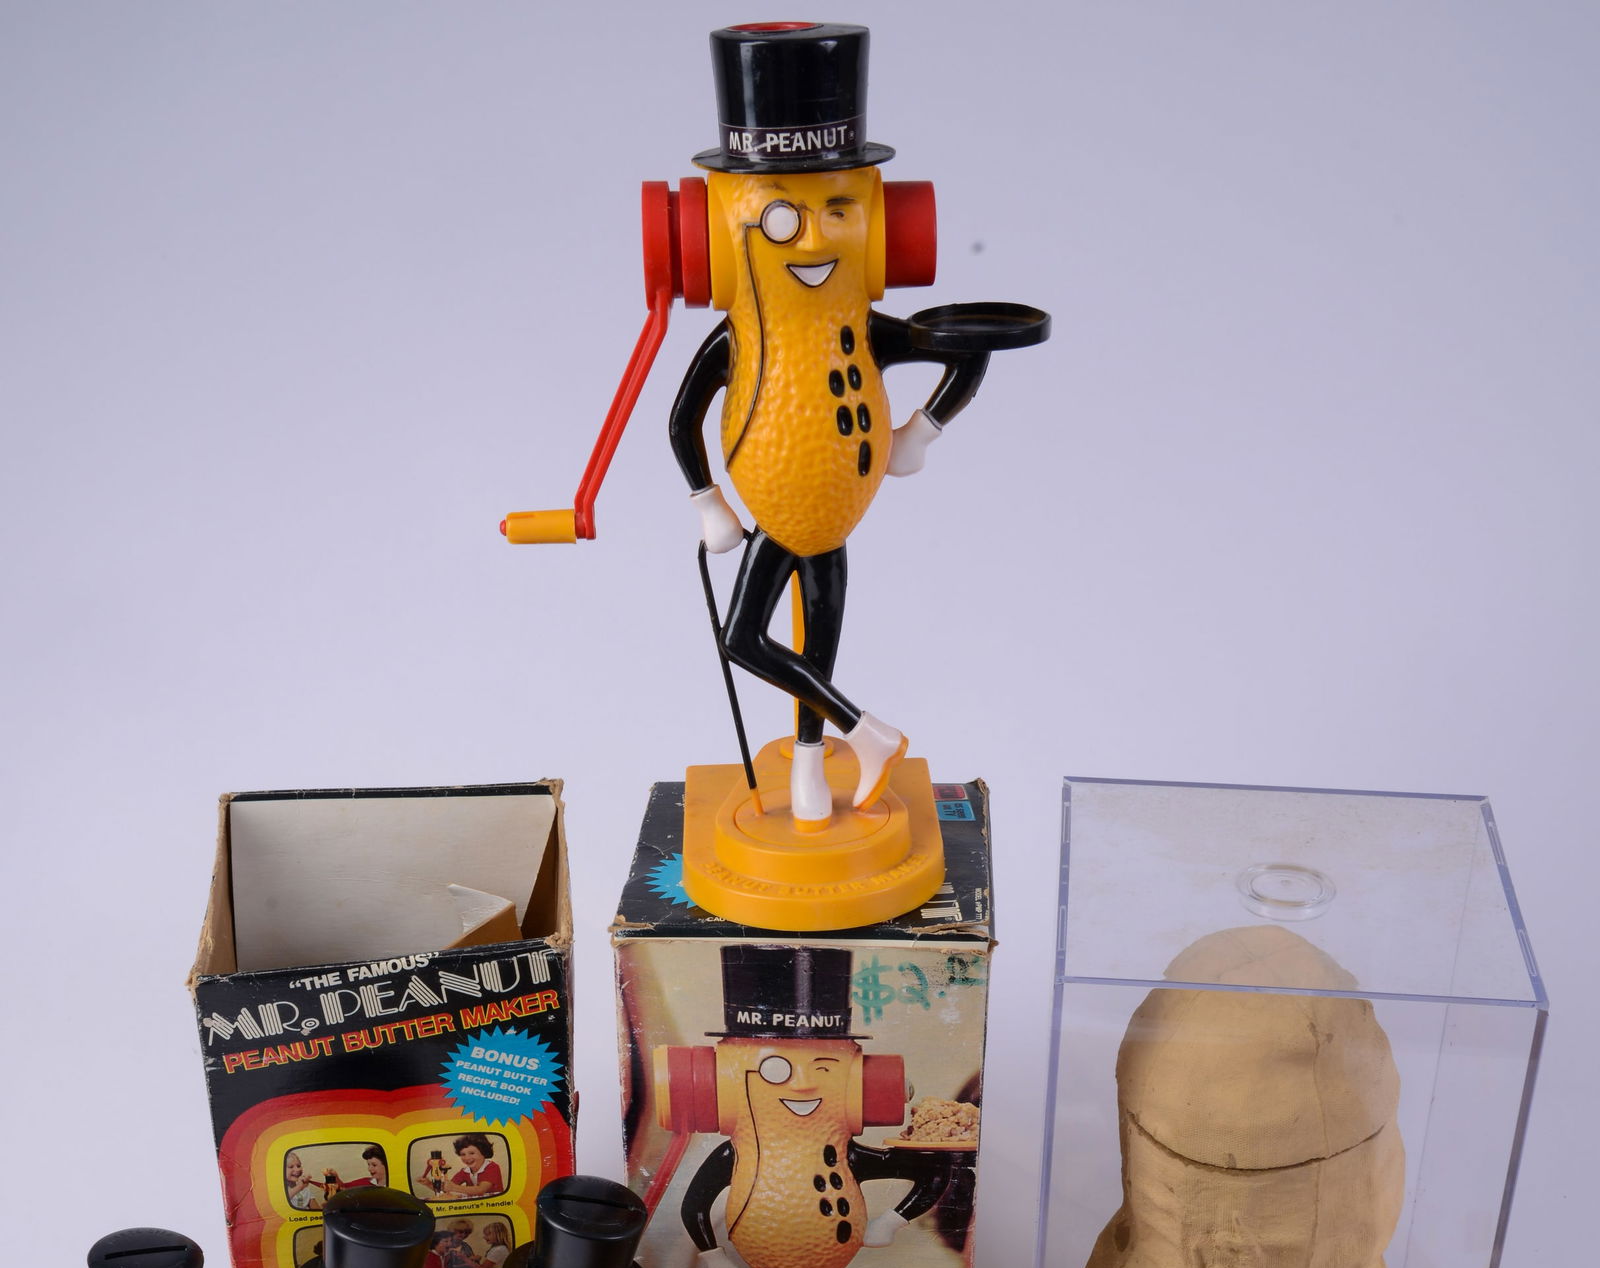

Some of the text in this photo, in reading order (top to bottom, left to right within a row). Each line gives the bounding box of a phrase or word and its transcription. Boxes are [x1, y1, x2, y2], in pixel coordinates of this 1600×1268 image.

[729, 131, 758, 153] MR.
[202, 949, 558, 1046] MR. PEANUT
[737, 1010, 767, 1026] MR.
[223, 989, 560, 1074] PEANUT BUTTER MAKER
[470, 1046, 540, 1071] BONUS
[456, 1060, 548, 1087] PEANUT BUTTER
[457, 1072, 532, 1096] RECIPE BOOK
[461, 1085, 521, 1106] INCLUDED!
